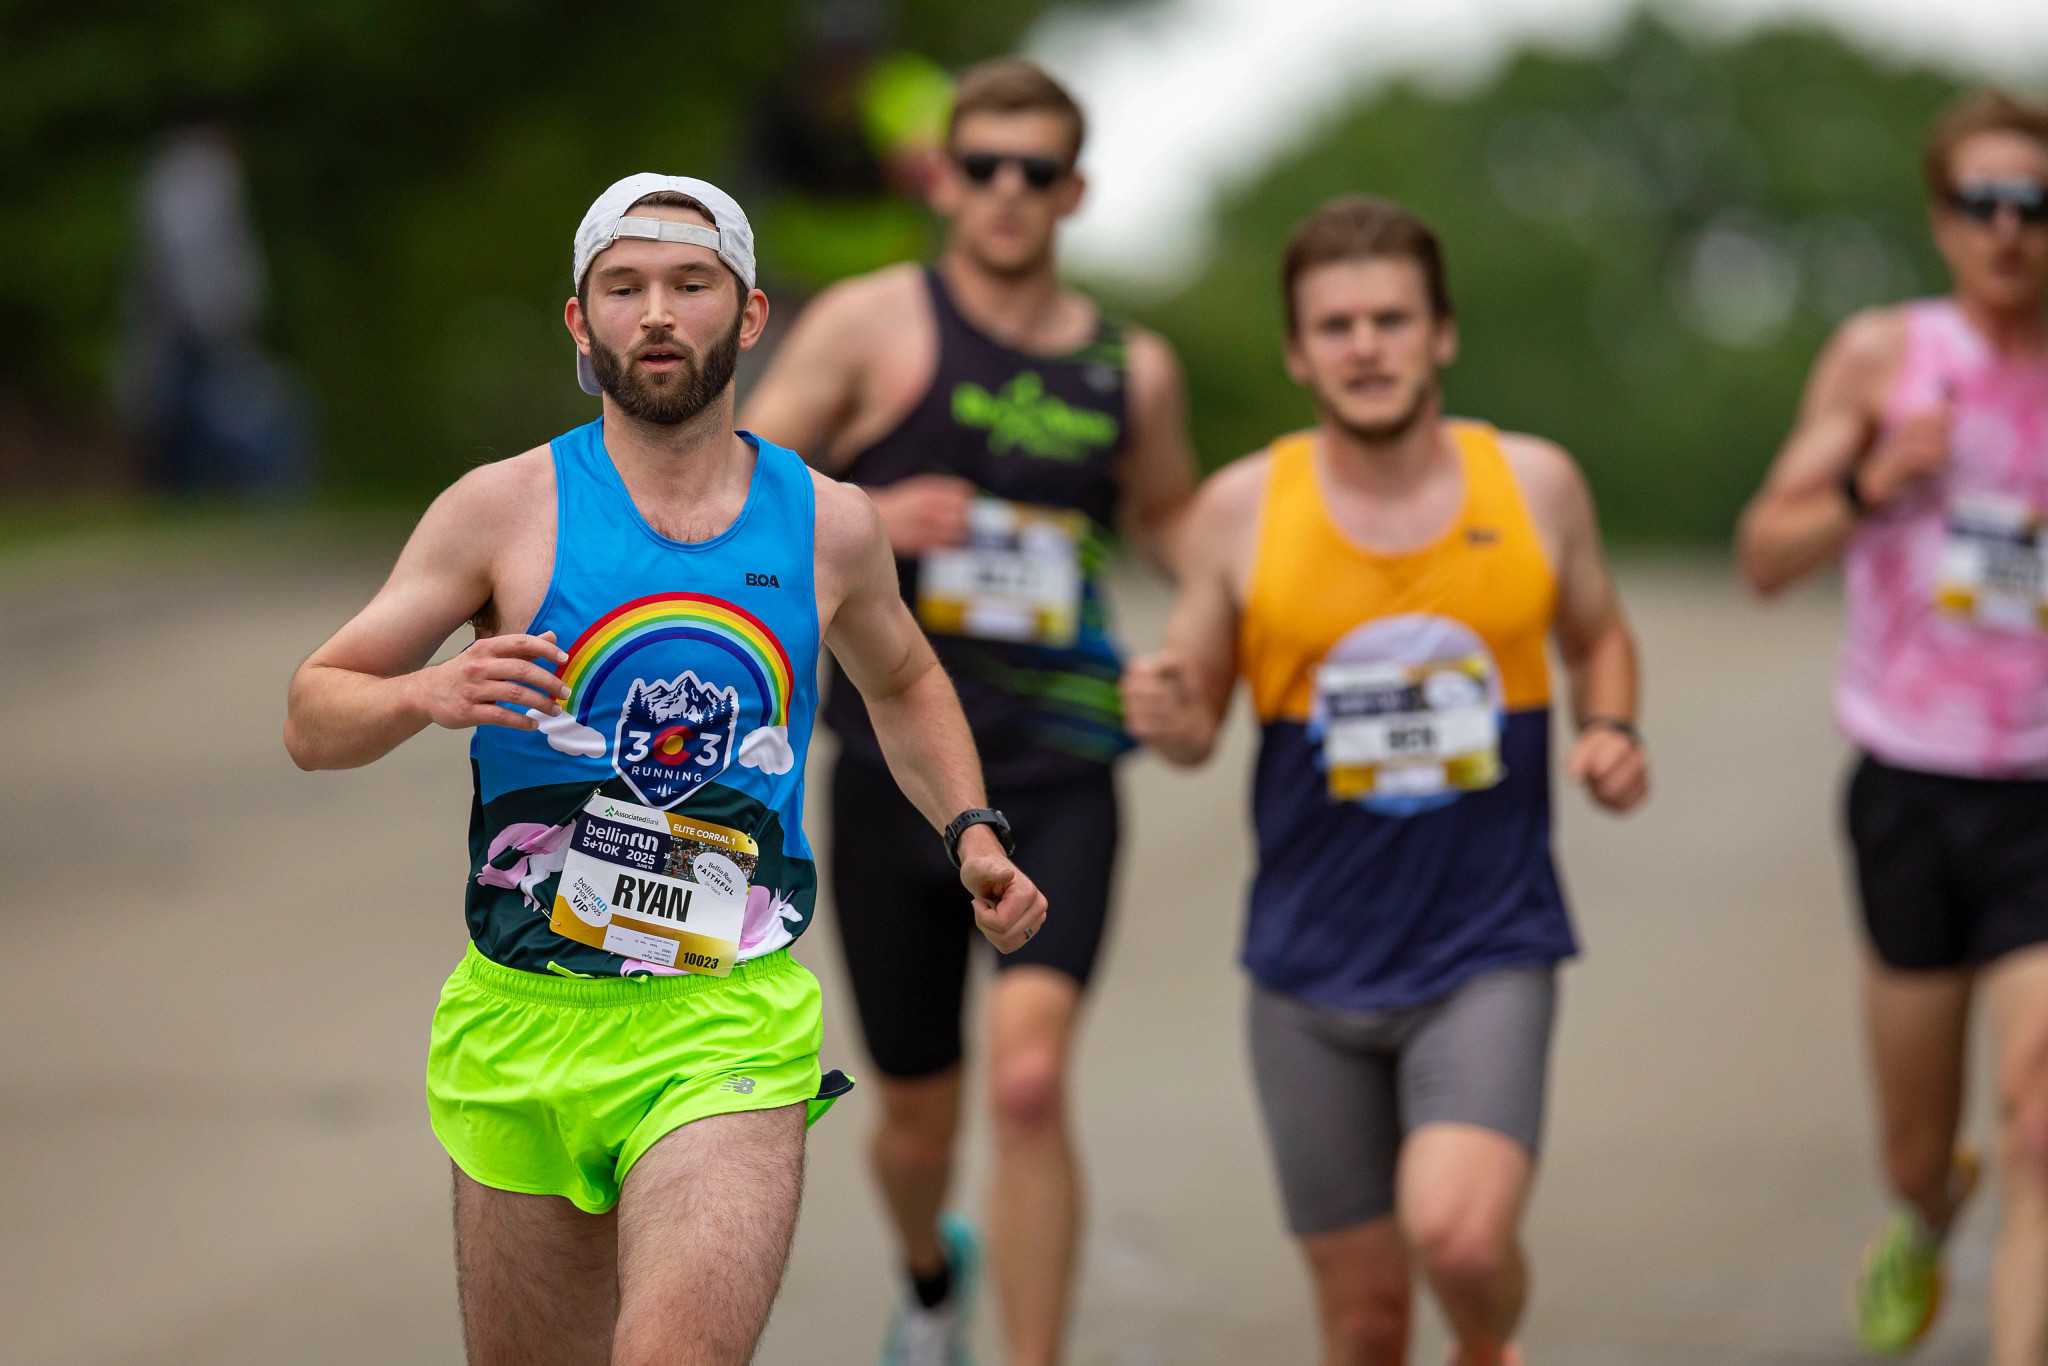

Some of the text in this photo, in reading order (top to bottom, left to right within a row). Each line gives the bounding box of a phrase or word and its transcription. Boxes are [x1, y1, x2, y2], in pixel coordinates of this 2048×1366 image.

[631, 766, 702, 783] RUNNING
[585, 819, 659, 853] bellinrun
[673, 823, 736, 846] ELITE CORRAL 1
[625, 849, 656, 865] 2025
[708, 862, 723, 875] Bellin
[697, 864, 734, 896] FAITHFUL
[572, 894, 589, 913] VIP
[611, 873, 693, 923] RYAN
[588, 901, 603, 917] 2025
[684, 951, 719, 970] 10023
